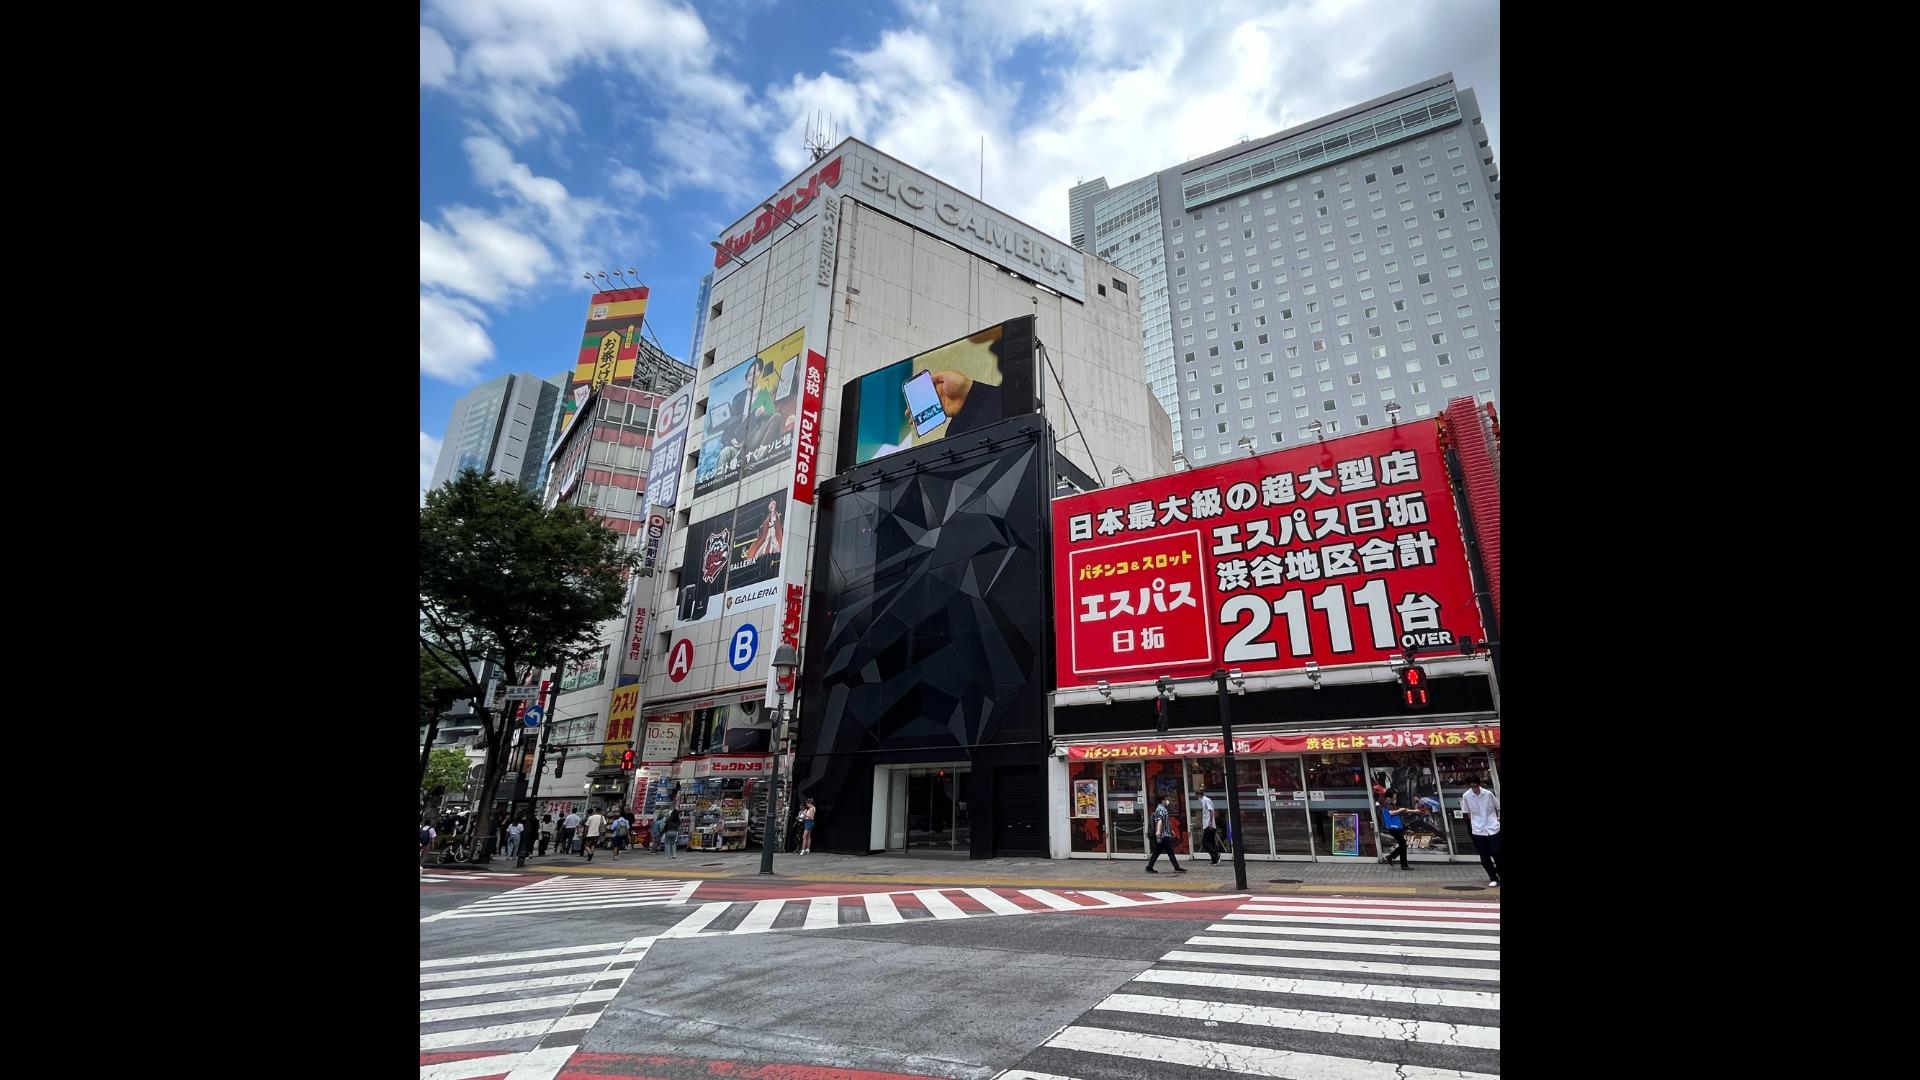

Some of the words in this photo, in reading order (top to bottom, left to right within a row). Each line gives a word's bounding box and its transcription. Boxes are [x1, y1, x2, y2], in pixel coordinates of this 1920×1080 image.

[715, 156, 843, 269] ビックカメラ
[861, 158, 925, 209] BIC
[935, 201, 1075, 283] CAMERA
[818, 225, 834, 287] CAMERA
[805, 366, 820, 397] 免税
[658, 396, 689, 435] OS
[1069, 450, 1419, 542] 日本最大級の超大型店
[1212, 492, 1427, 556] エスパス日拓
[730, 557, 756, 572] GALLERIA
[1079, 550, 1192, 581] パチンコ&スロット
[1216, 531, 1436, 591] 渋谷地区合計
[734, 586, 778, 605] GALLERIA
[1080, 577, 1197, 622] エスパス
[629, 607, 647, 661] 処方せん受付
[734, 630, 753, 666] B
[1112, 626, 1165, 653] 日拓
[1401, 631, 1453, 648] OVER
[671, 642, 688, 676] A
[613, 691, 639, 714] クスリ
[648, 727, 660, 739] 10
[712, 762, 763, 771] ビックカメラ
